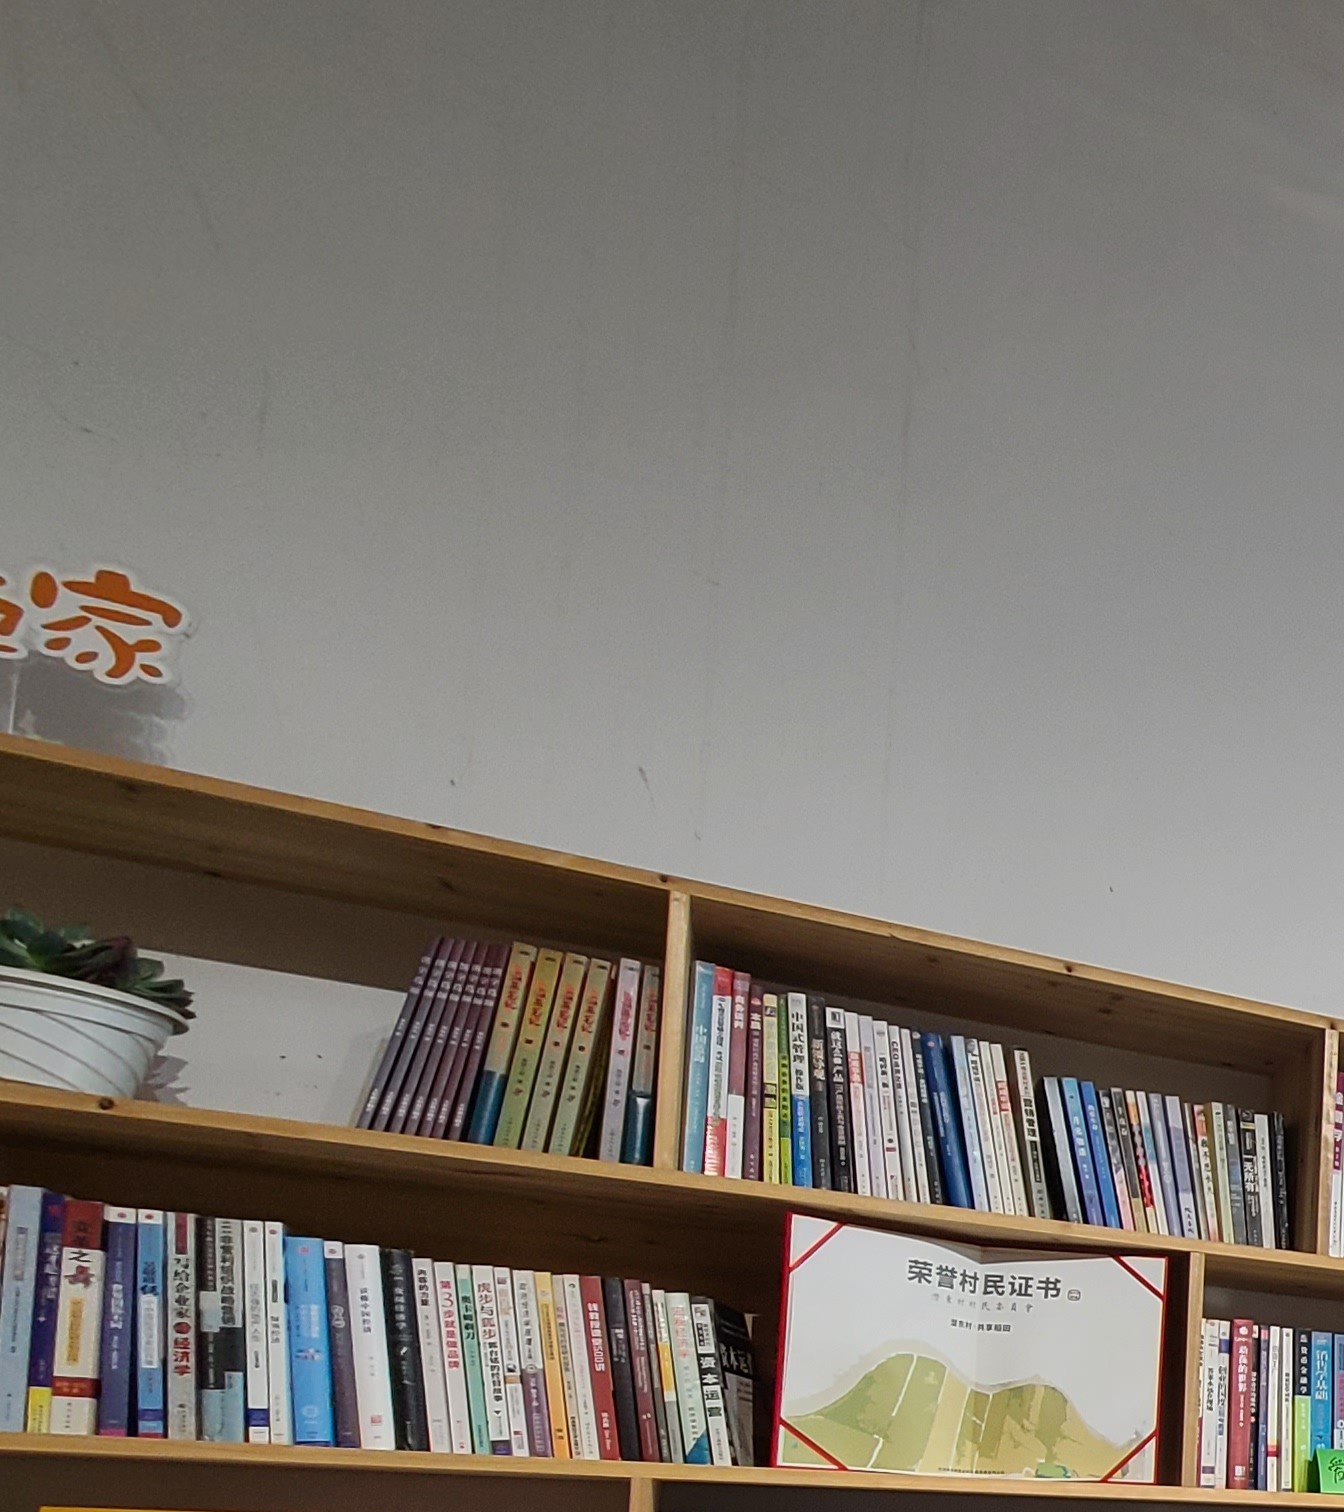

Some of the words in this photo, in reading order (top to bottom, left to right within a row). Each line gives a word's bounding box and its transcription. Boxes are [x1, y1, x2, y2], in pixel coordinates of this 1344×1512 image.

[907, 1258, 1062, 1299] 荣誉村民证书
[477, 1281, 497, 1341] 虎步与狐步
